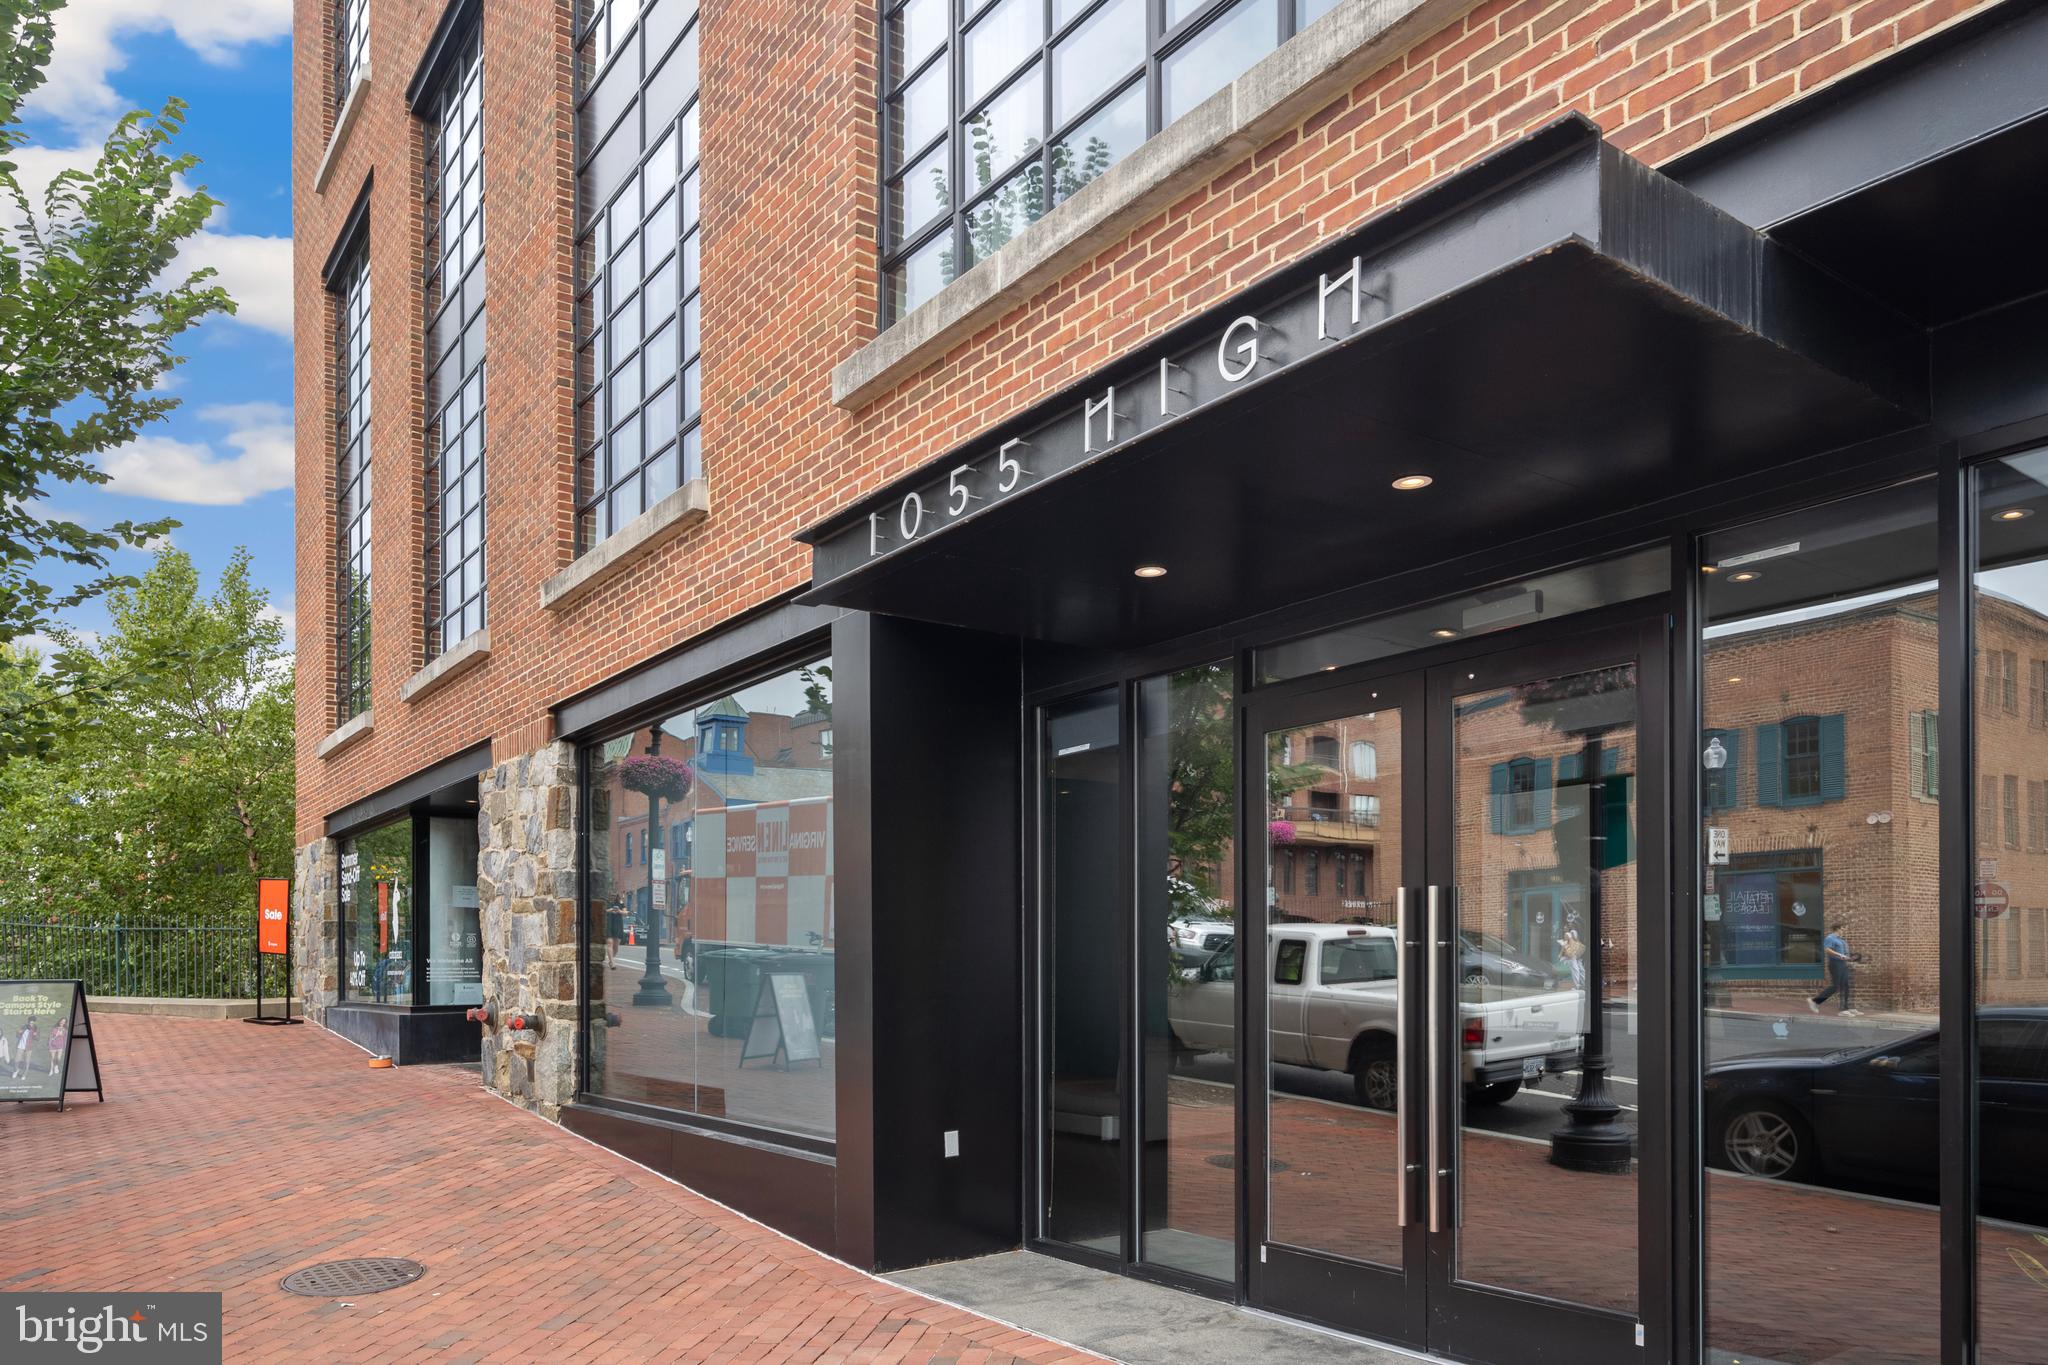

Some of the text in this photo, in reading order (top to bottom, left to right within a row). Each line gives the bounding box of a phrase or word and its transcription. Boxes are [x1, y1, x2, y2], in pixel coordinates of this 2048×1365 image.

[869, 255, 1362, 558] 1055 HIGH
[341, 853, 359, 869] Summer
[341, 865, 360, 886] Send-Off
[341, 886, 351, 903] Sale
[264, 908, 283, 920] Sale
[353, 950, 366, 970] Up To
[13, 994, 49, 1002] Back To
[37, 1001, 62, 1009] Style
